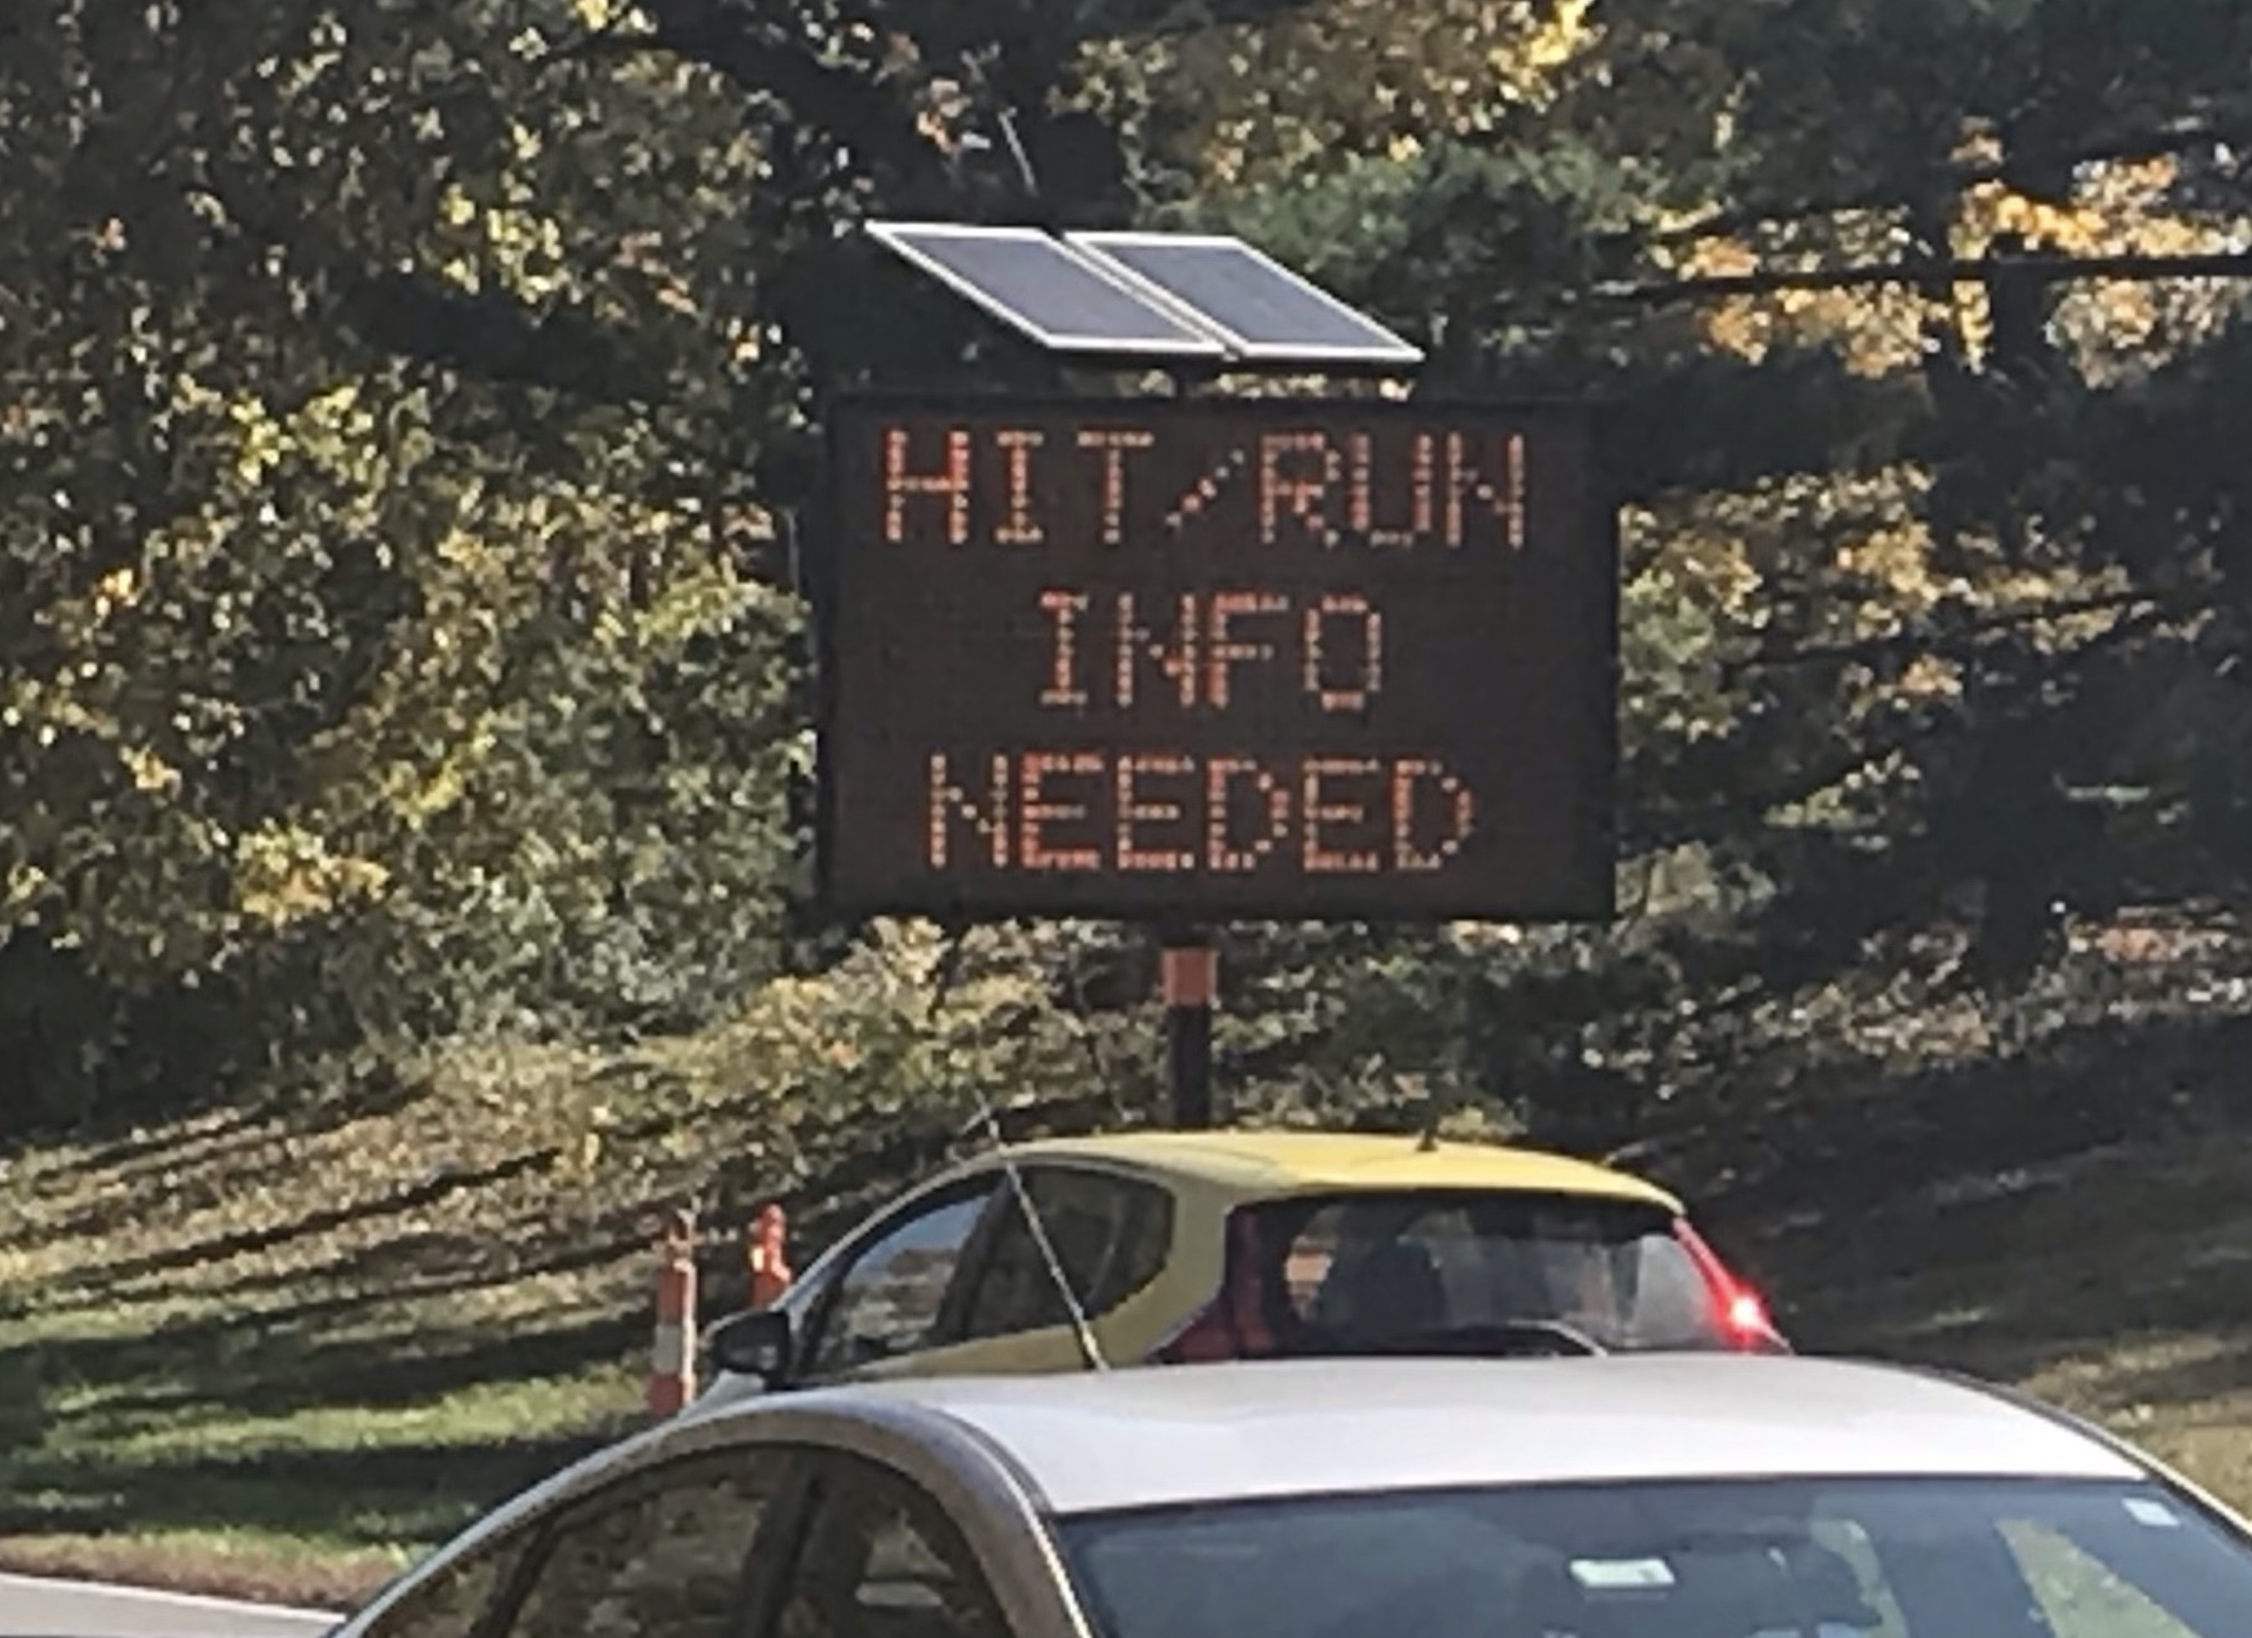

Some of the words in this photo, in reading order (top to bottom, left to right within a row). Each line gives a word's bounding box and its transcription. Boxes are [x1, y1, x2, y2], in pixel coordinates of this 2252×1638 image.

[884, 429, 1526, 548] HIT/RUN
[1038, 591, 1383, 709] INFO
[928, 752, 1475, 871] NEEDED
